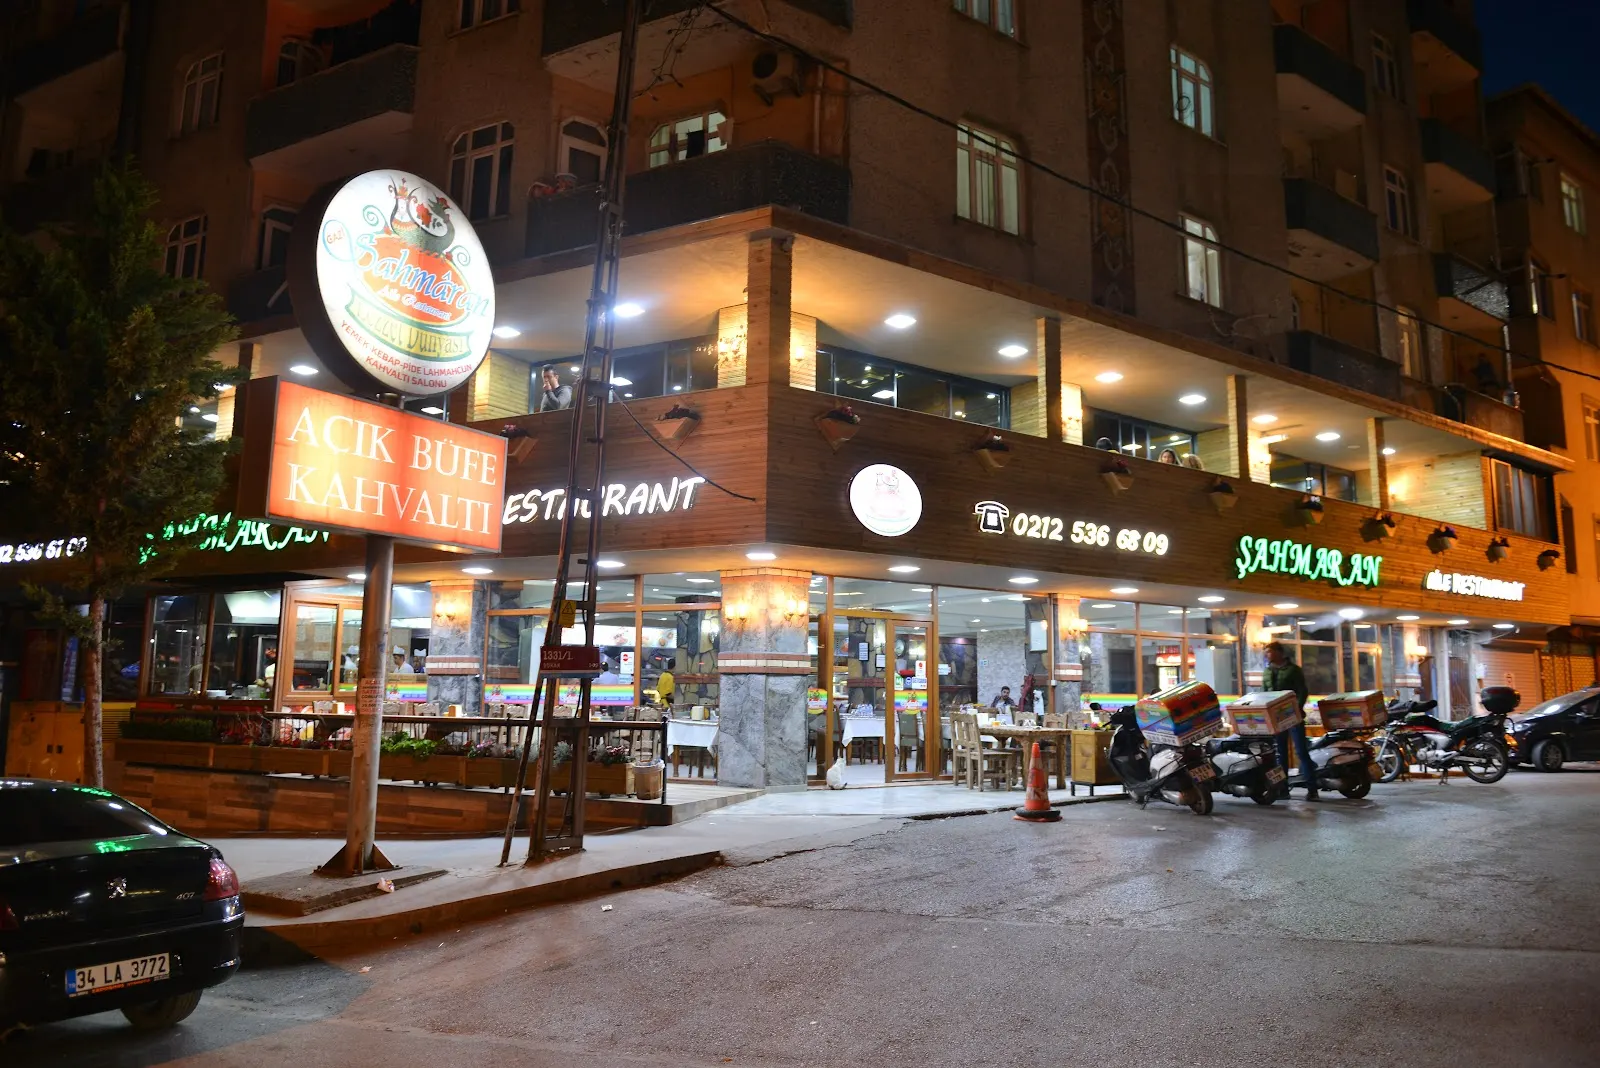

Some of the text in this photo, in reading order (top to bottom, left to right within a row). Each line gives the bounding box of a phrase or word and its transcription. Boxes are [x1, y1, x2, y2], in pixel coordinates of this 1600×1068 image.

[365, 355, 447, 388] KAHVALTI SALONU
[287, 407, 498, 486] AÇIK BÜFE
[284, 462, 493, 535] KAHVALTI
[1012, 512, 1169, 556] 0212 536 68 09
[176, 891, 196, 900] 407
[77, 970, 96, 989] 34
[103, 964, 123, 984] LA
[131, 955, 166, 978] 3772
